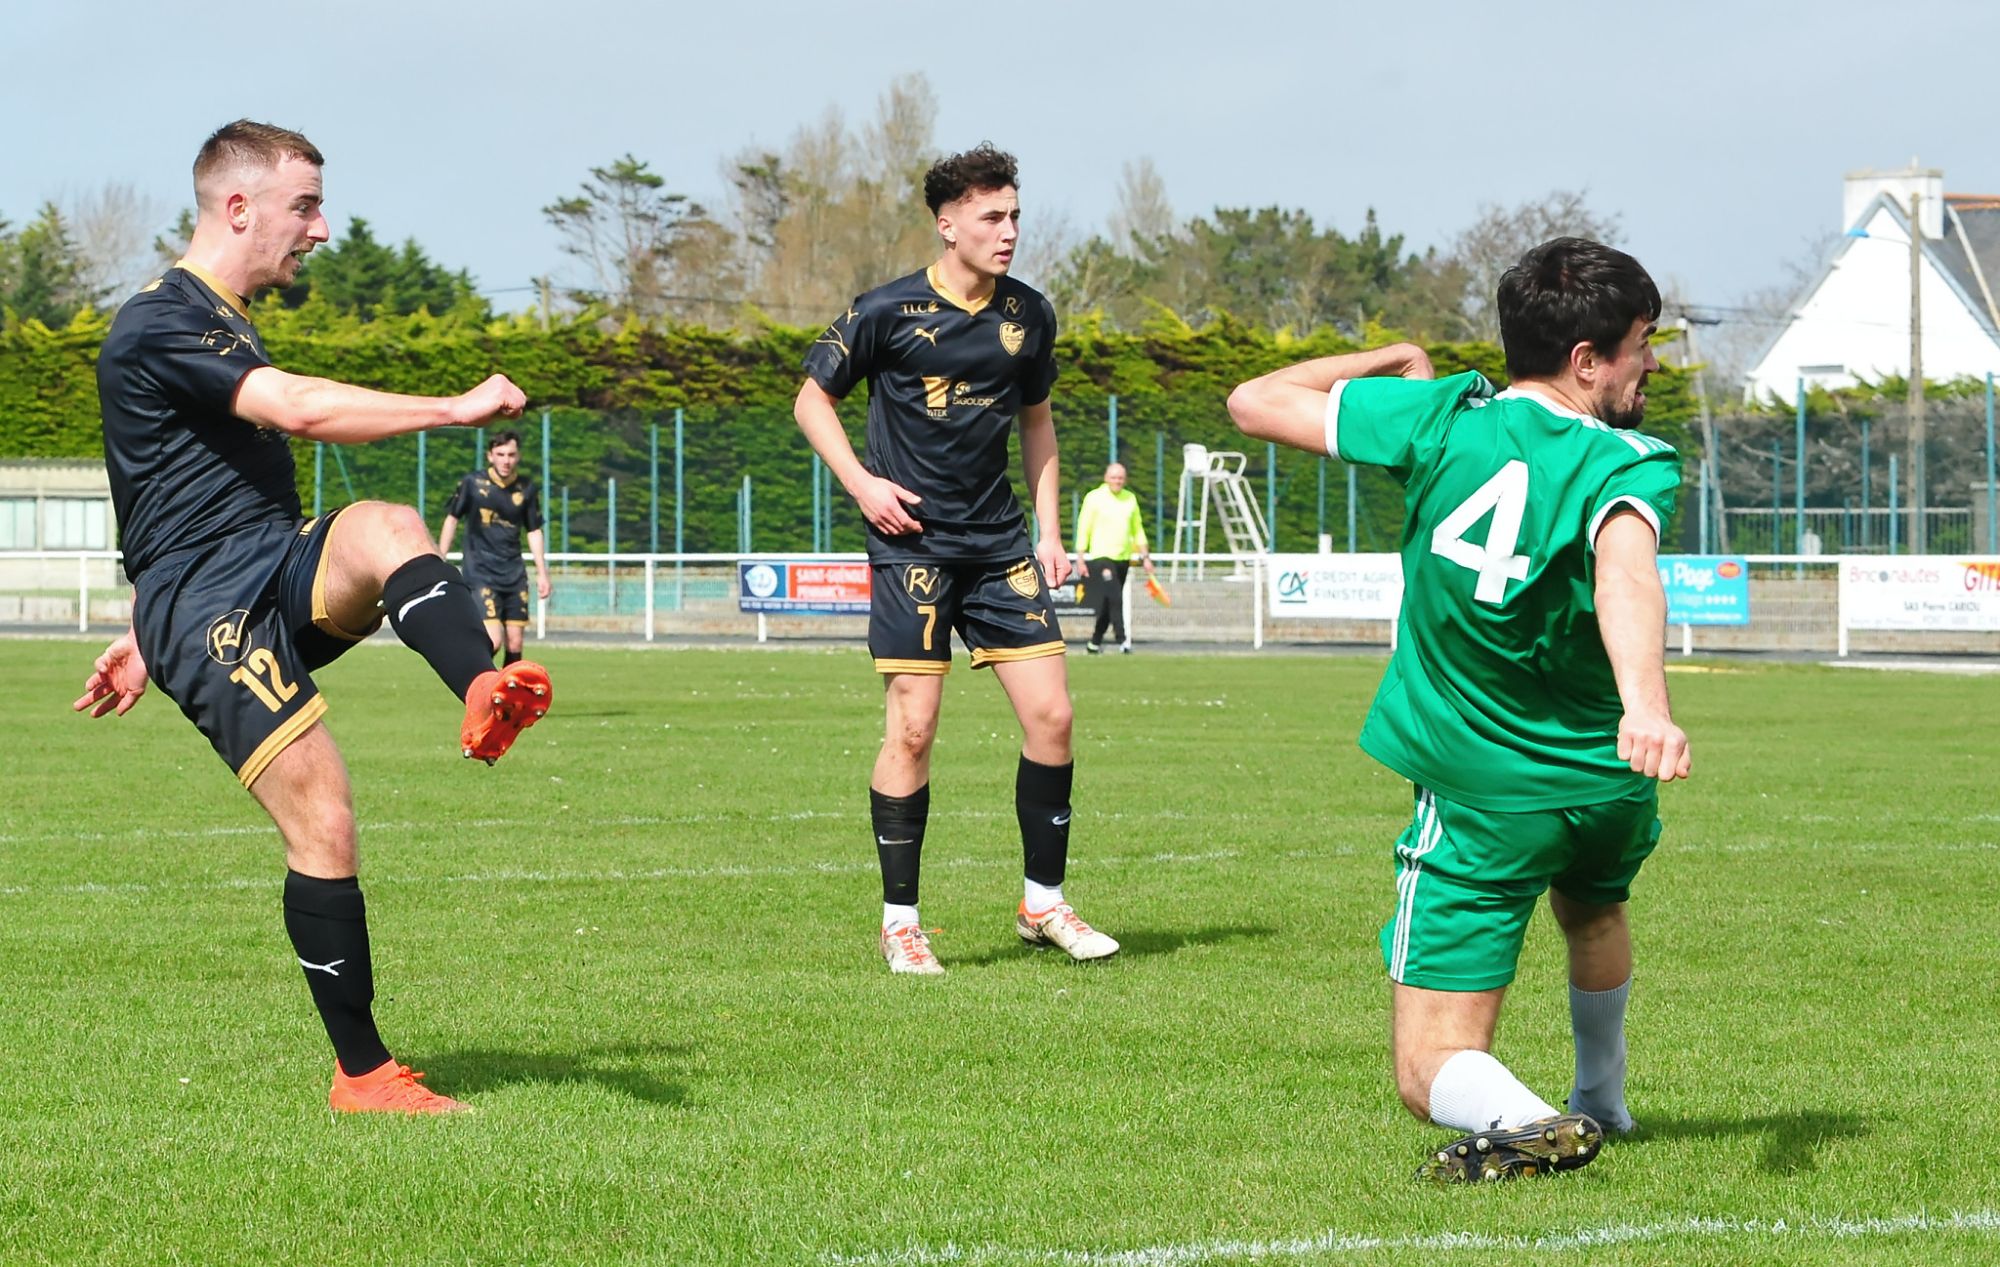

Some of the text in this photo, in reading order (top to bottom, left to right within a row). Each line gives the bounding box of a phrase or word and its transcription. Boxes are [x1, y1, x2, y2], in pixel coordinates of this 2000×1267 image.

[901, 303, 927, 315] TLC
[1430, 459, 1531, 604] 4
[484, 598, 496, 618] 3
[917, 605, 937, 650] 7
[229, 648, 299, 713] 12
